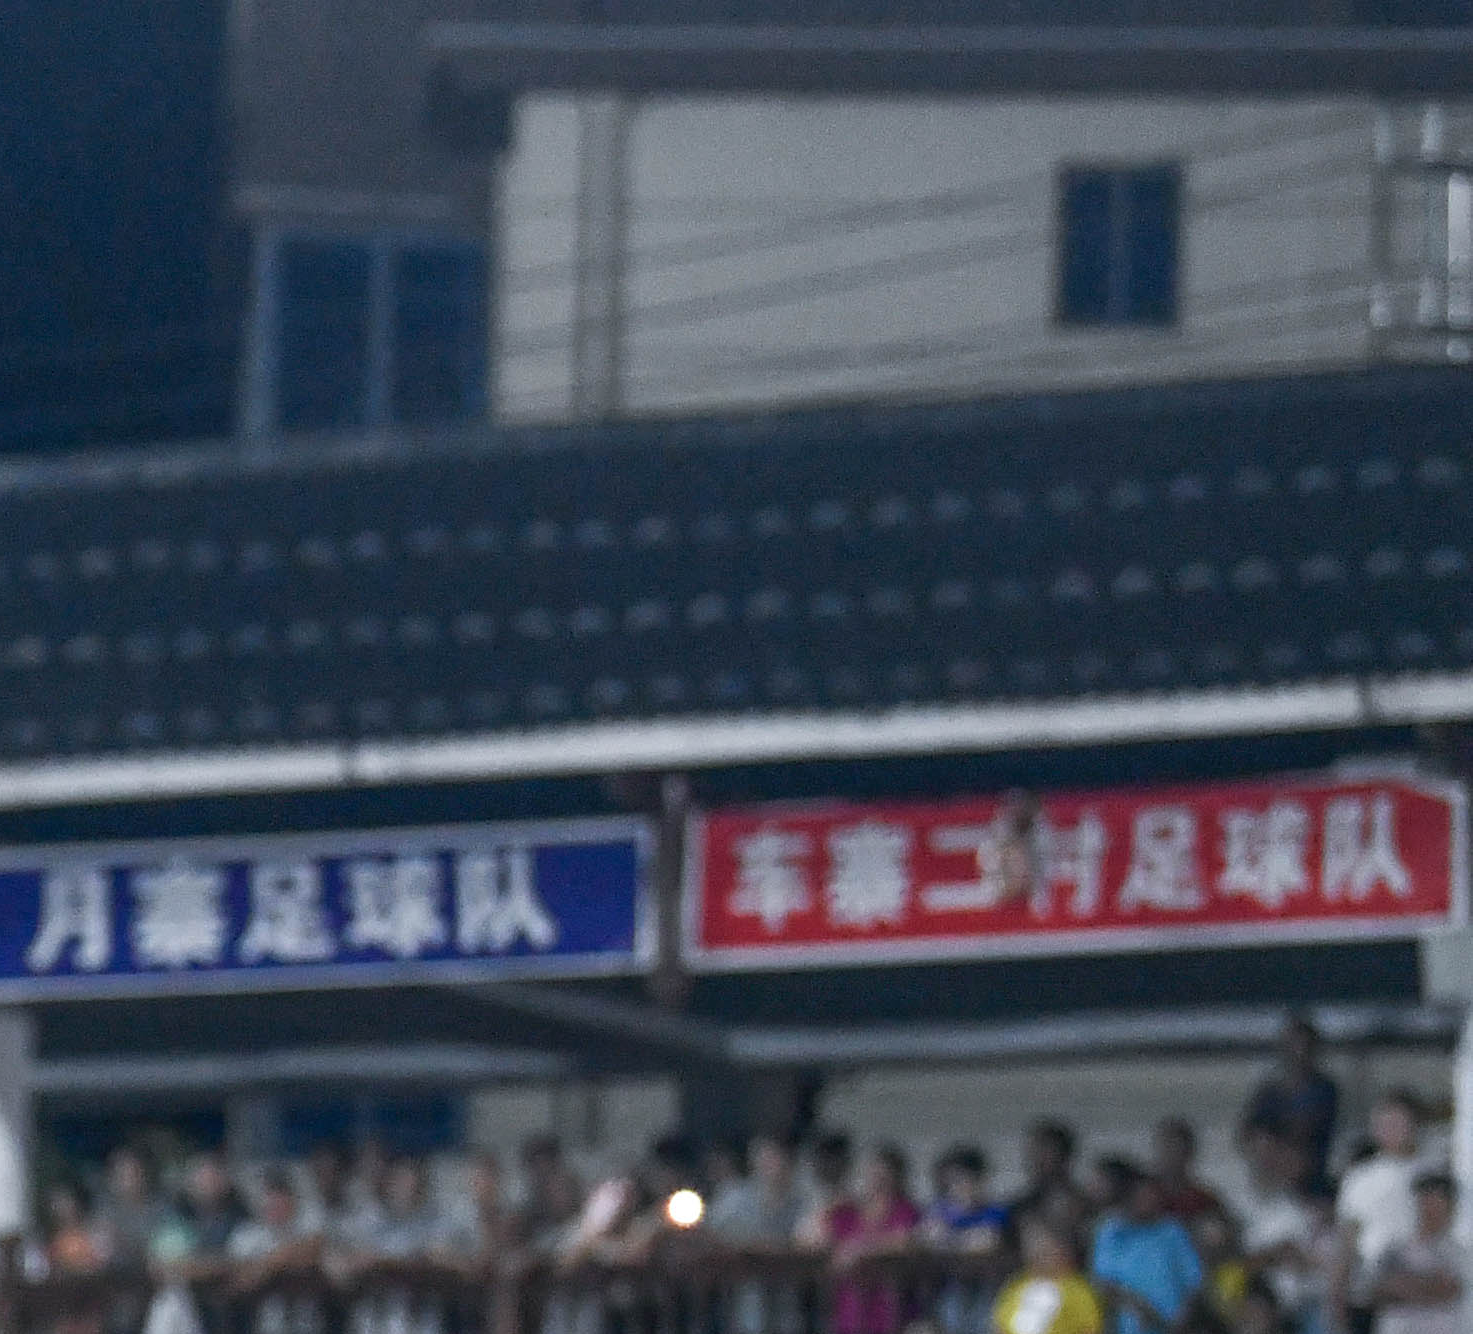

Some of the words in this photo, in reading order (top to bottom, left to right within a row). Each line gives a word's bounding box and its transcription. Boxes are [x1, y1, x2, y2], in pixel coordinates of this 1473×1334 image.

[26, 842, 559, 970] 月寨足球队
